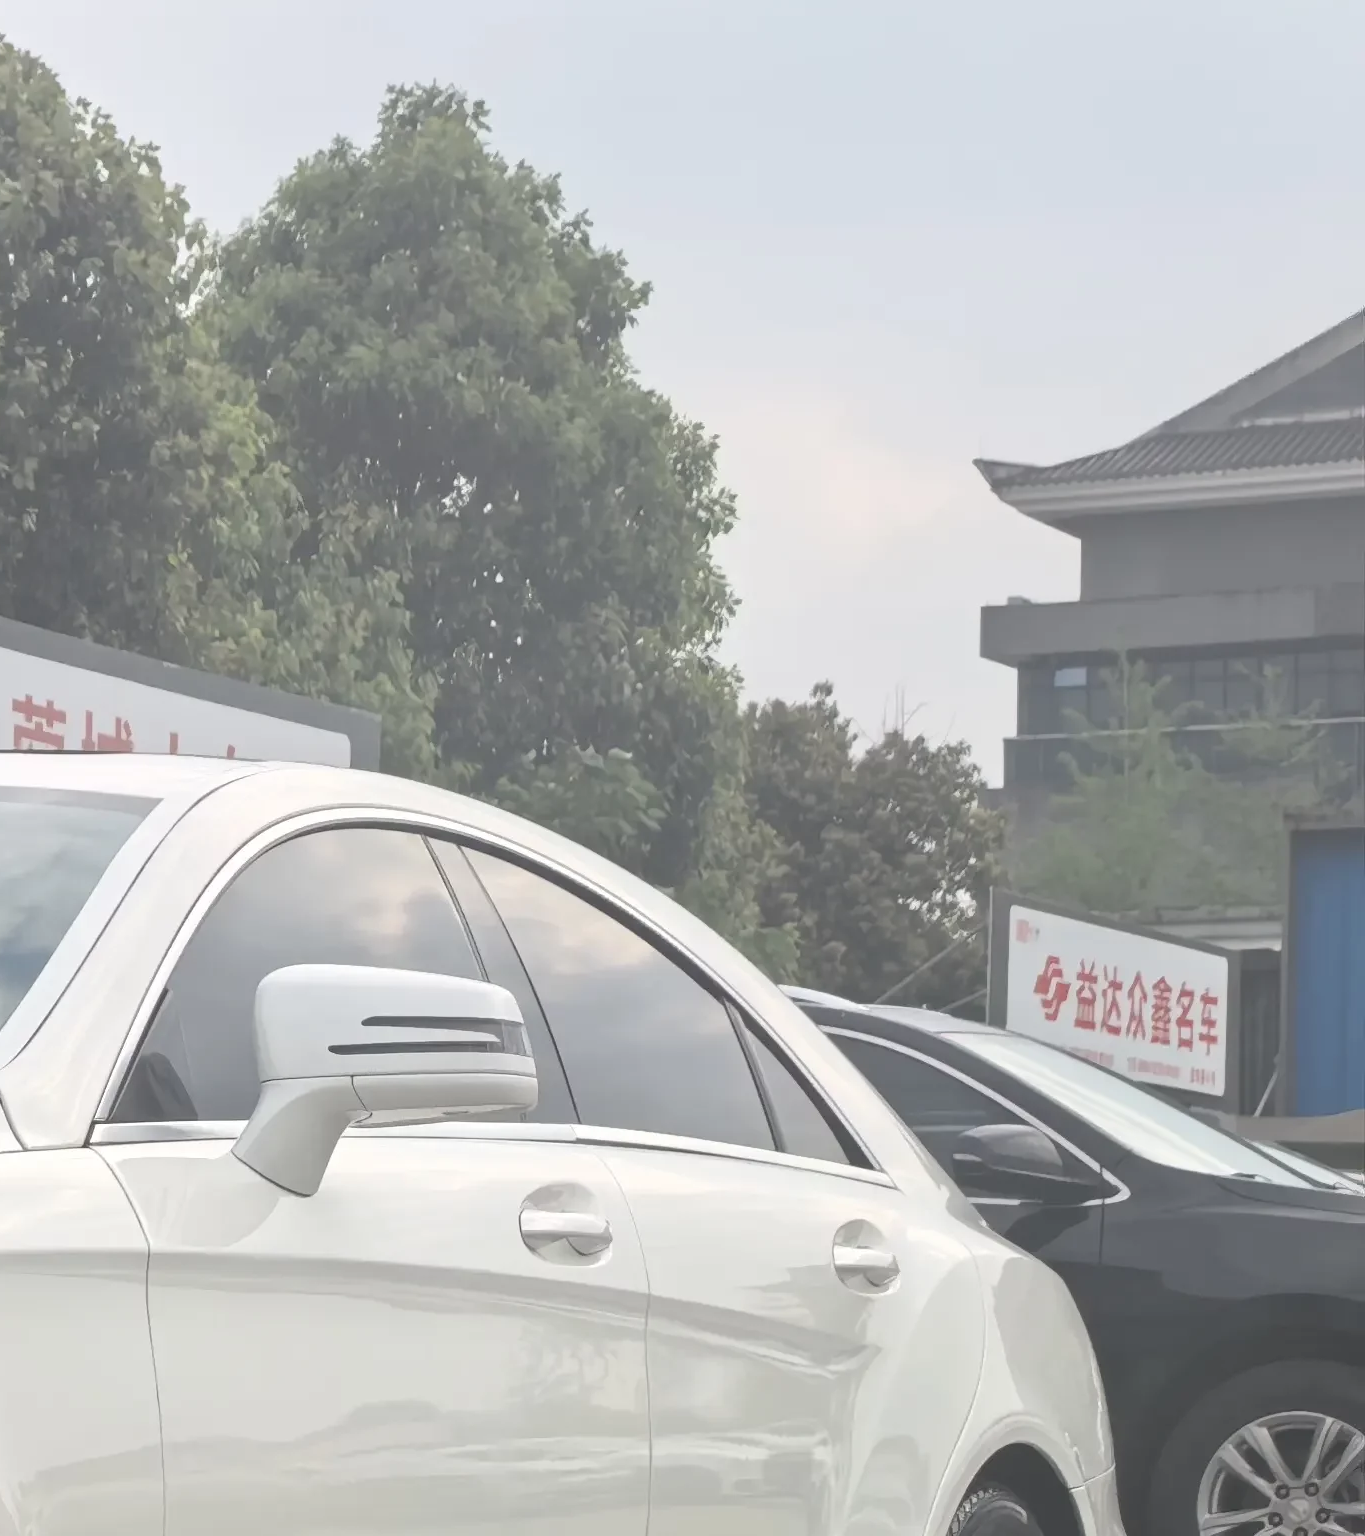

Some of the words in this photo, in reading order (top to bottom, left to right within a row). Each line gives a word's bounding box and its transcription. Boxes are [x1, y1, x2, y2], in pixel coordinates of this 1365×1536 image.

[1073, 957, 1219, 1056] 益达众鑫名车
